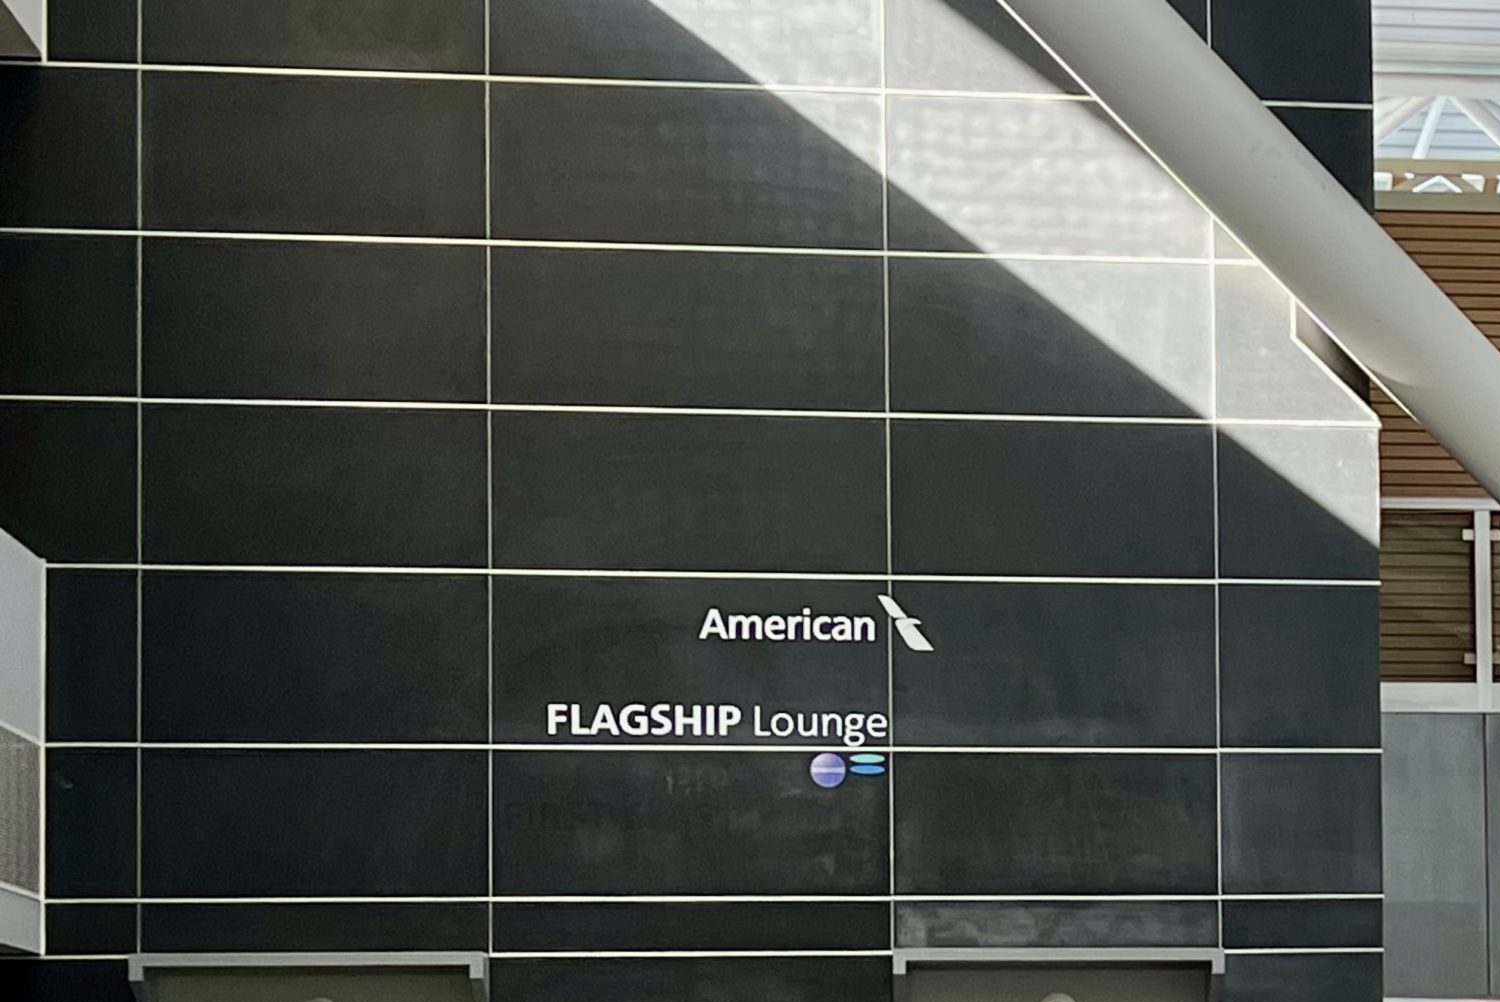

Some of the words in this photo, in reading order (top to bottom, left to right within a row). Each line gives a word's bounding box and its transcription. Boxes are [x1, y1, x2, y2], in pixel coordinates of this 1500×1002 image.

[699, 607, 876, 642] American
[546, 702, 742, 737] FLAGSHIP
[753, 704, 889, 748] Lounge
